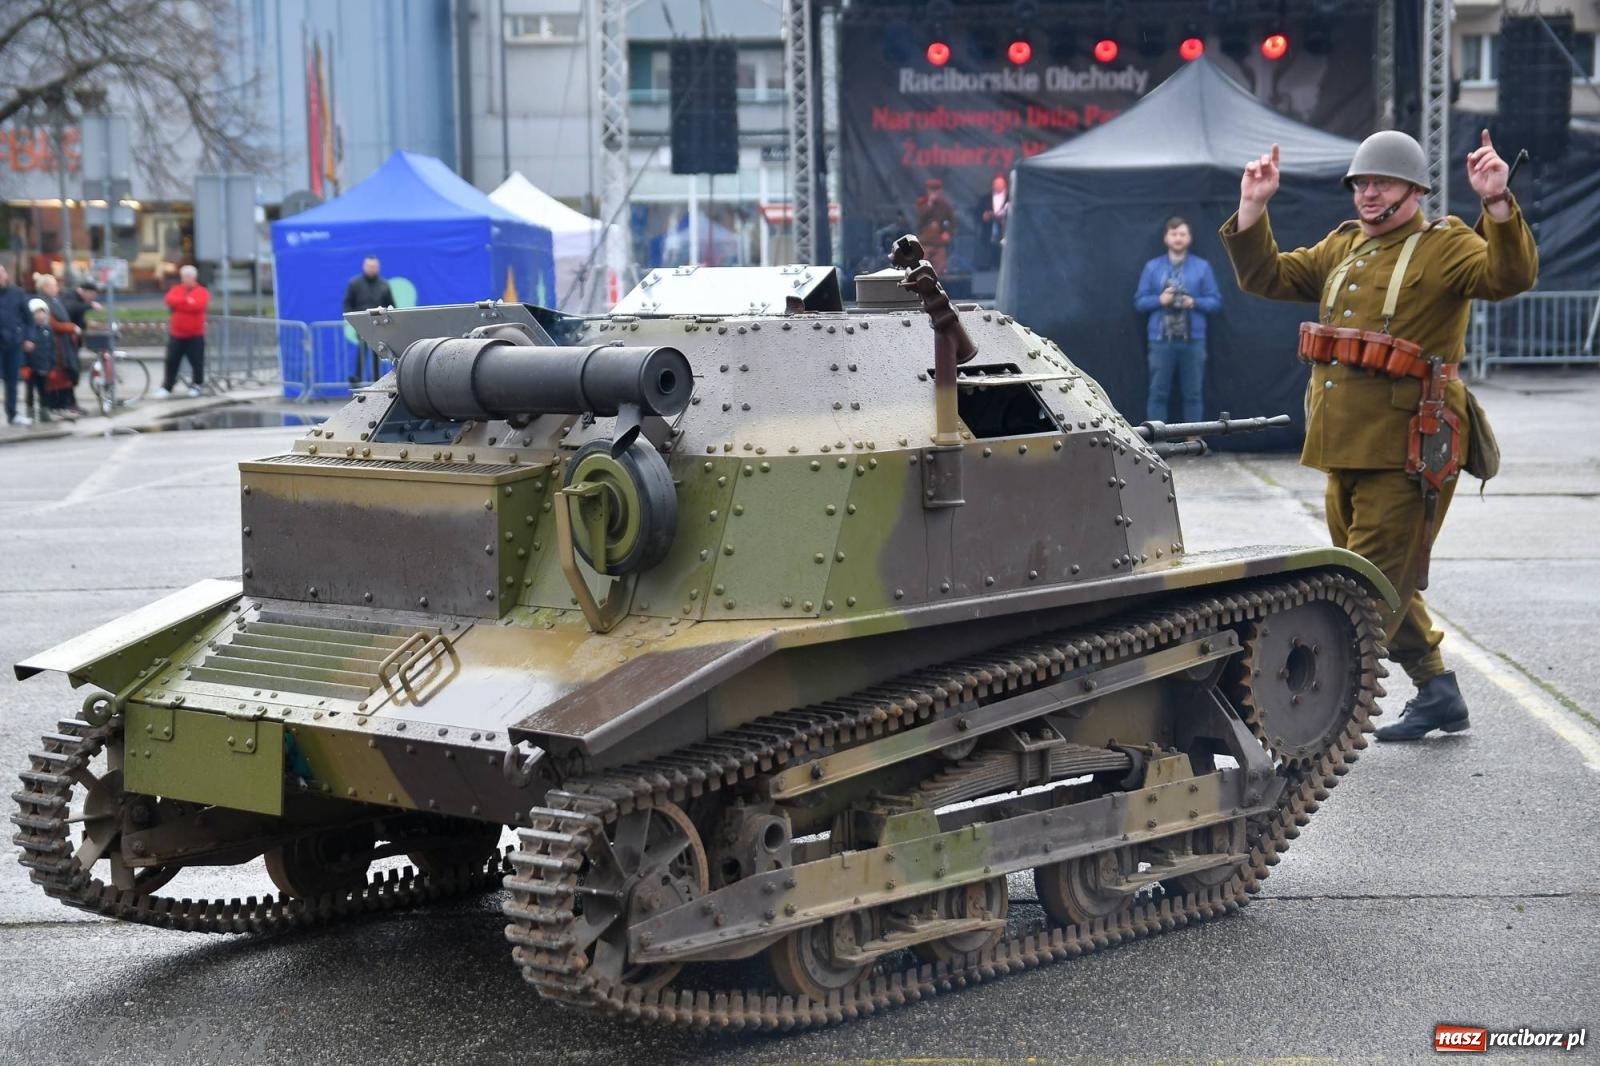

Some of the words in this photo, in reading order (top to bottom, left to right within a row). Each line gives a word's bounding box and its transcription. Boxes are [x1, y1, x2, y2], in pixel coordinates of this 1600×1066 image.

[899, 67, 1038, 92] Raciborskie
[1045, 66, 1148, 93] Obchody
[872, 105, 1021, 135] Narodowego
[1027, 104, 1078, 128] Dnia
[1084, 104, 1120, 128] Pa
